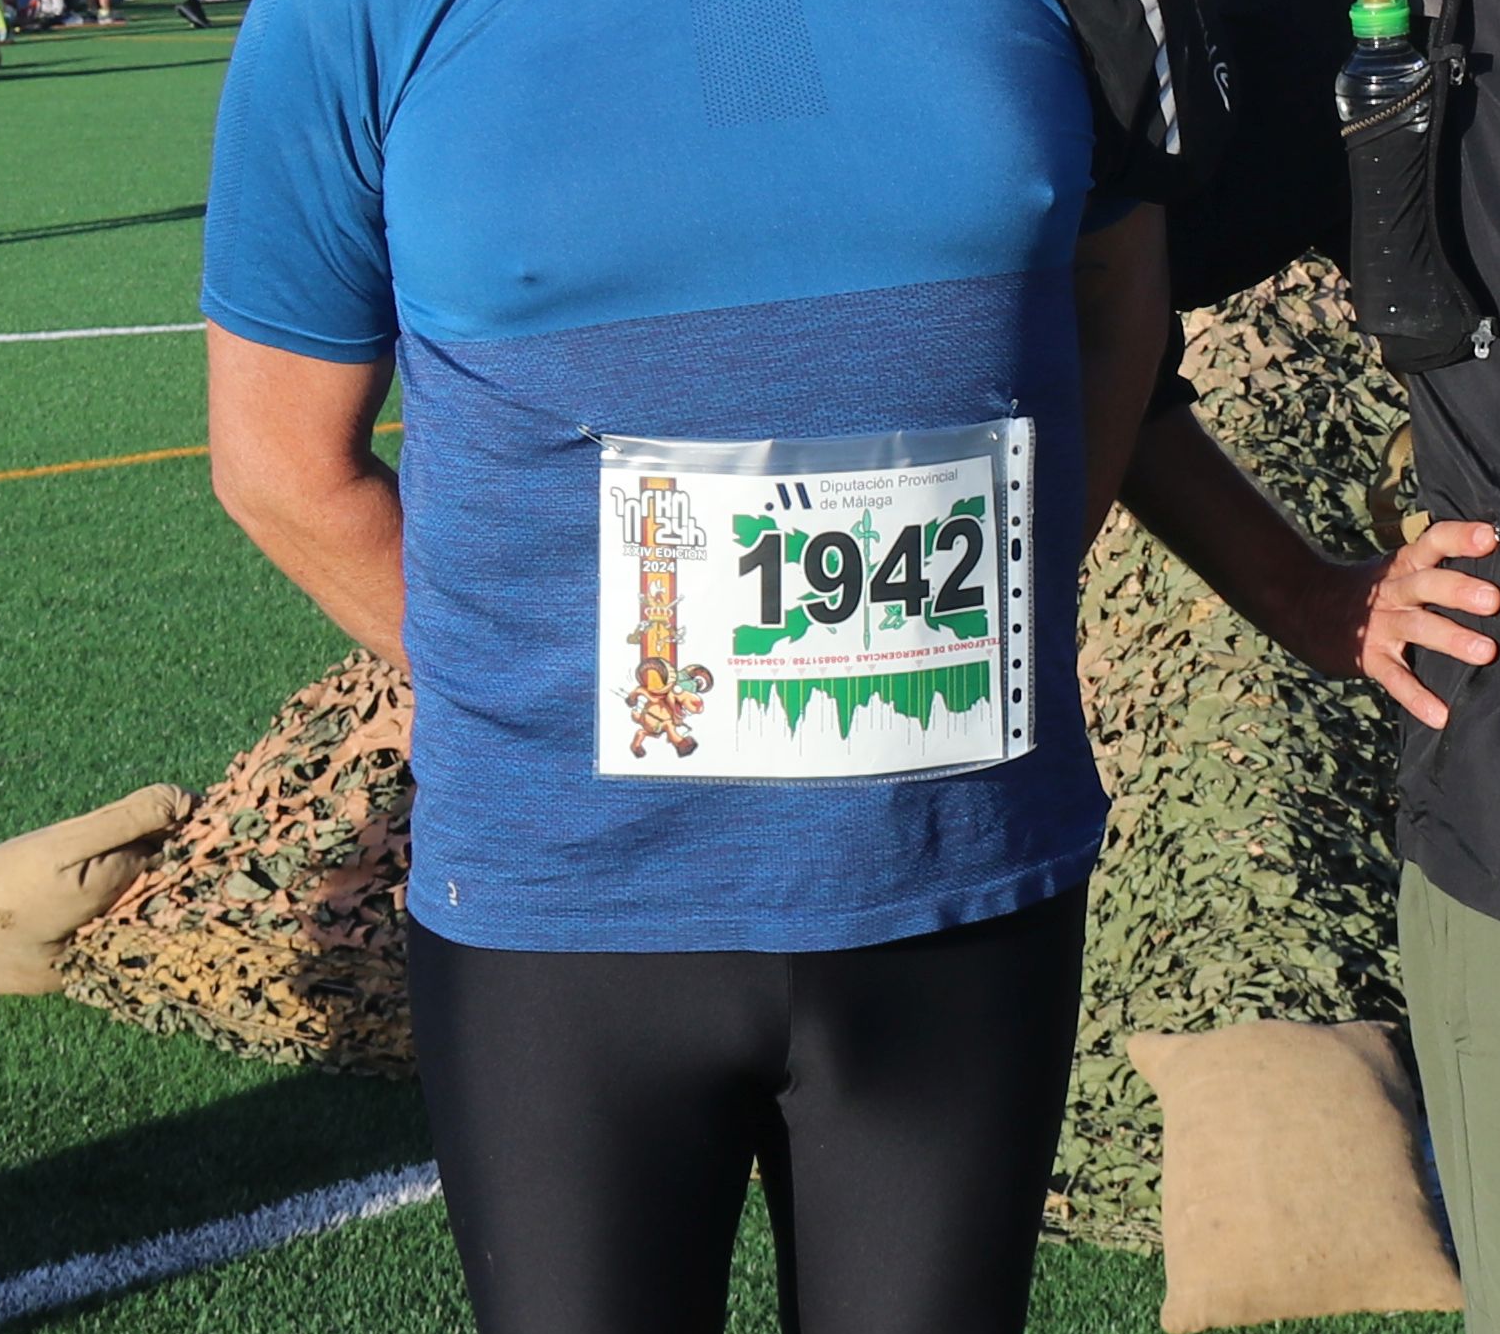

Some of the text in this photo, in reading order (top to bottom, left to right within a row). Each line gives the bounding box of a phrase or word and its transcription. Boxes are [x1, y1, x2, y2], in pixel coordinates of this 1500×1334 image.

[820, 469, 958, 494] Diputación Provincial
[820, 495, 893, 510] de Málaga
[623, 545, 708, 561] XXIV EDICIÓN
[643, 560, 676, 573] 2024
[738, 518, 986, 626] 1942
[856, 647, 930, 663] EMERGENCIAS
